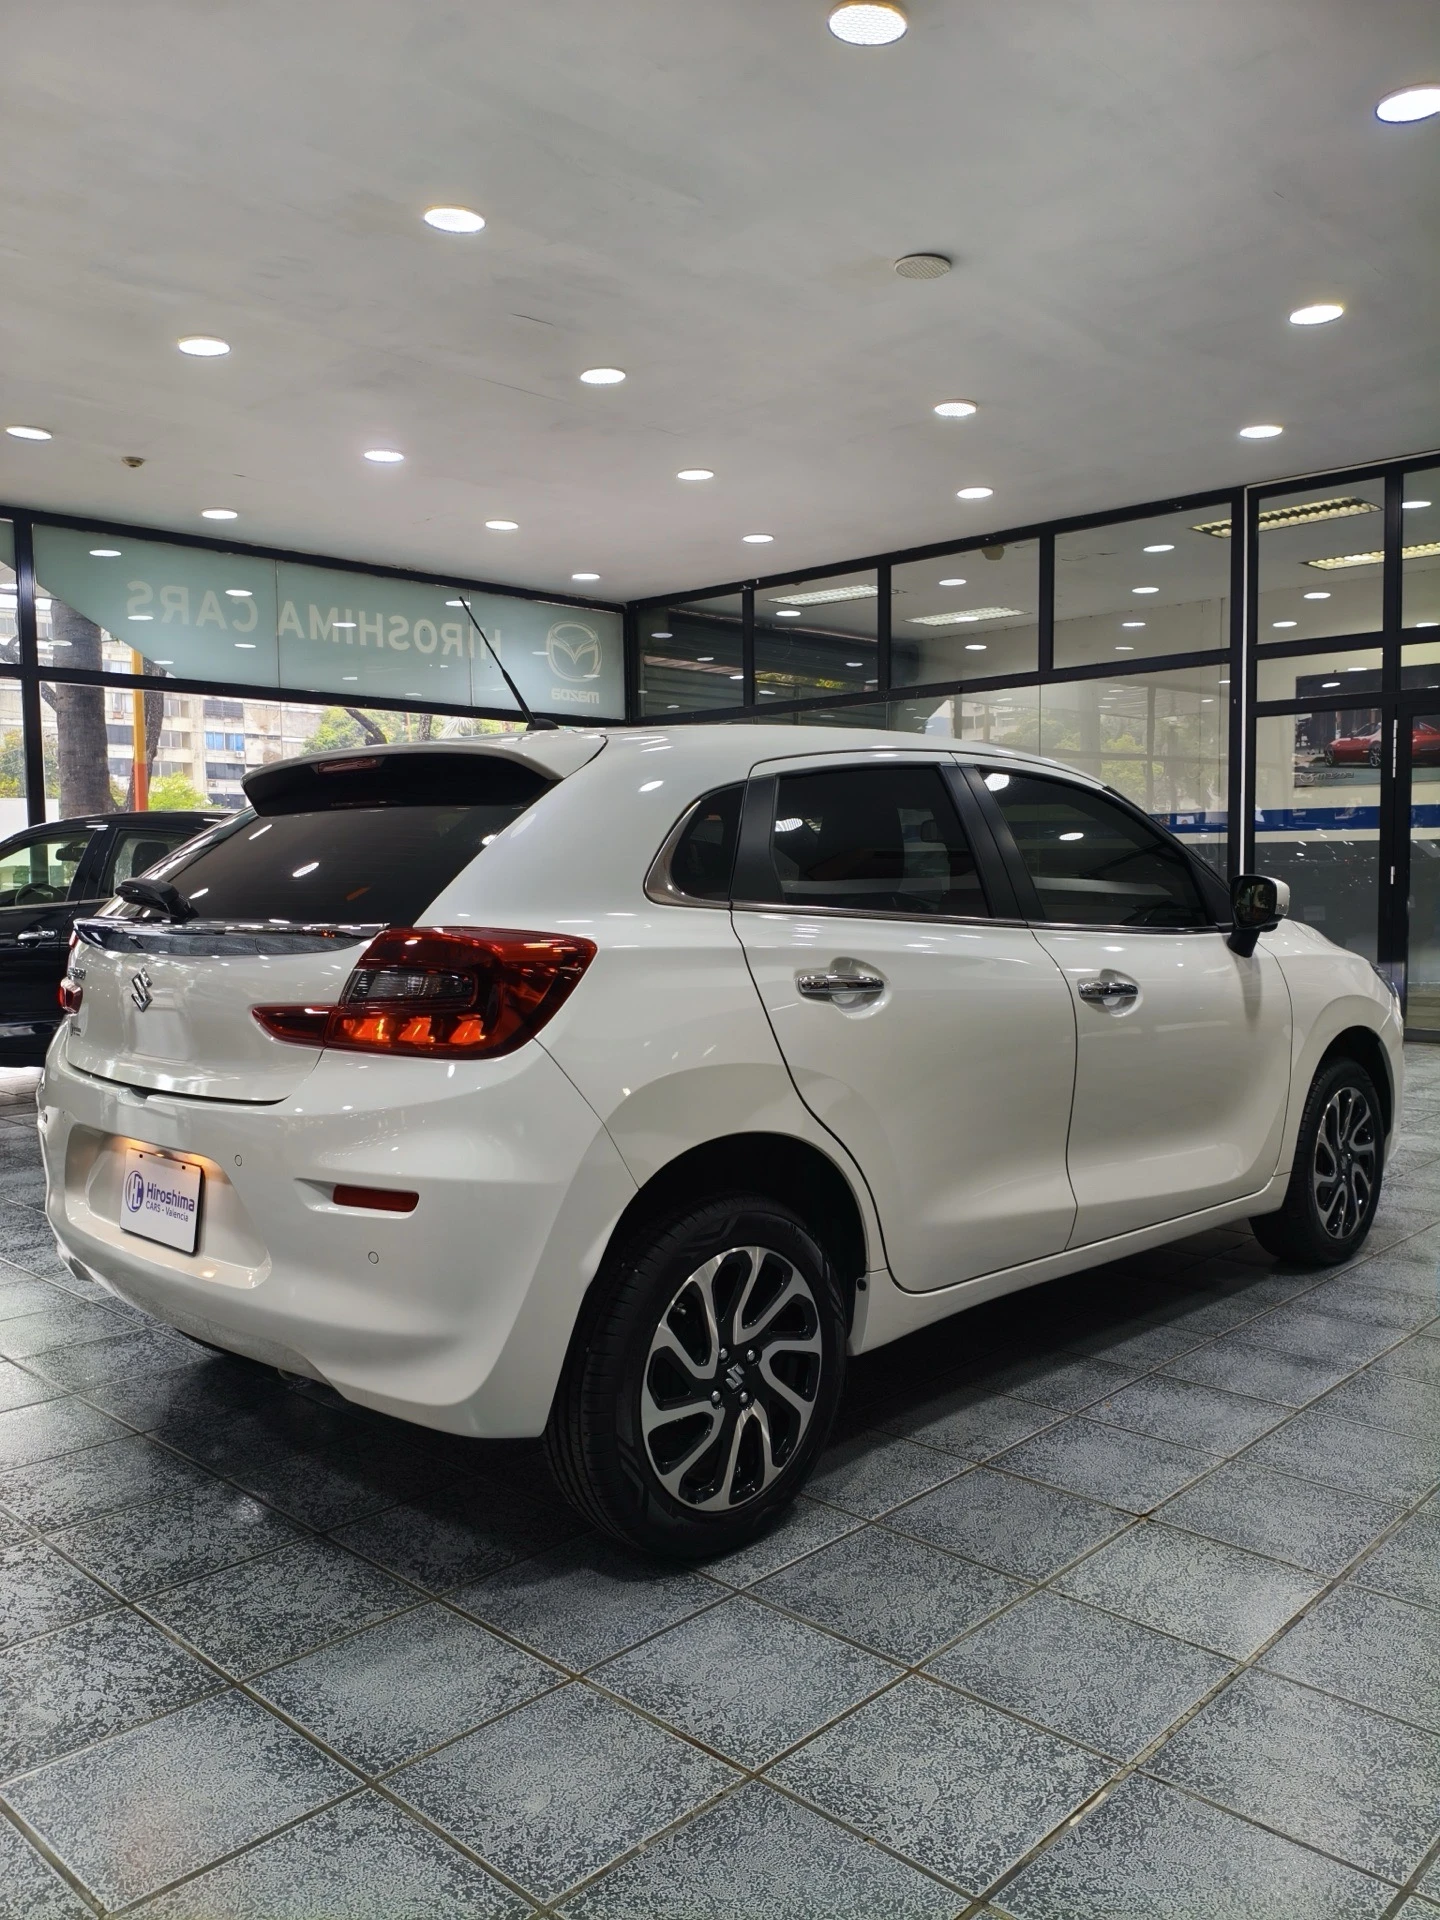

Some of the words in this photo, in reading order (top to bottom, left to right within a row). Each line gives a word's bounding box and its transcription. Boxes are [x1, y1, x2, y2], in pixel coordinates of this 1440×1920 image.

[146, 1182, 195, 1212] Hiroshima
[146, 1200, 161, 1213] CARS
[165, 1206, 189, 1222] Valencia
